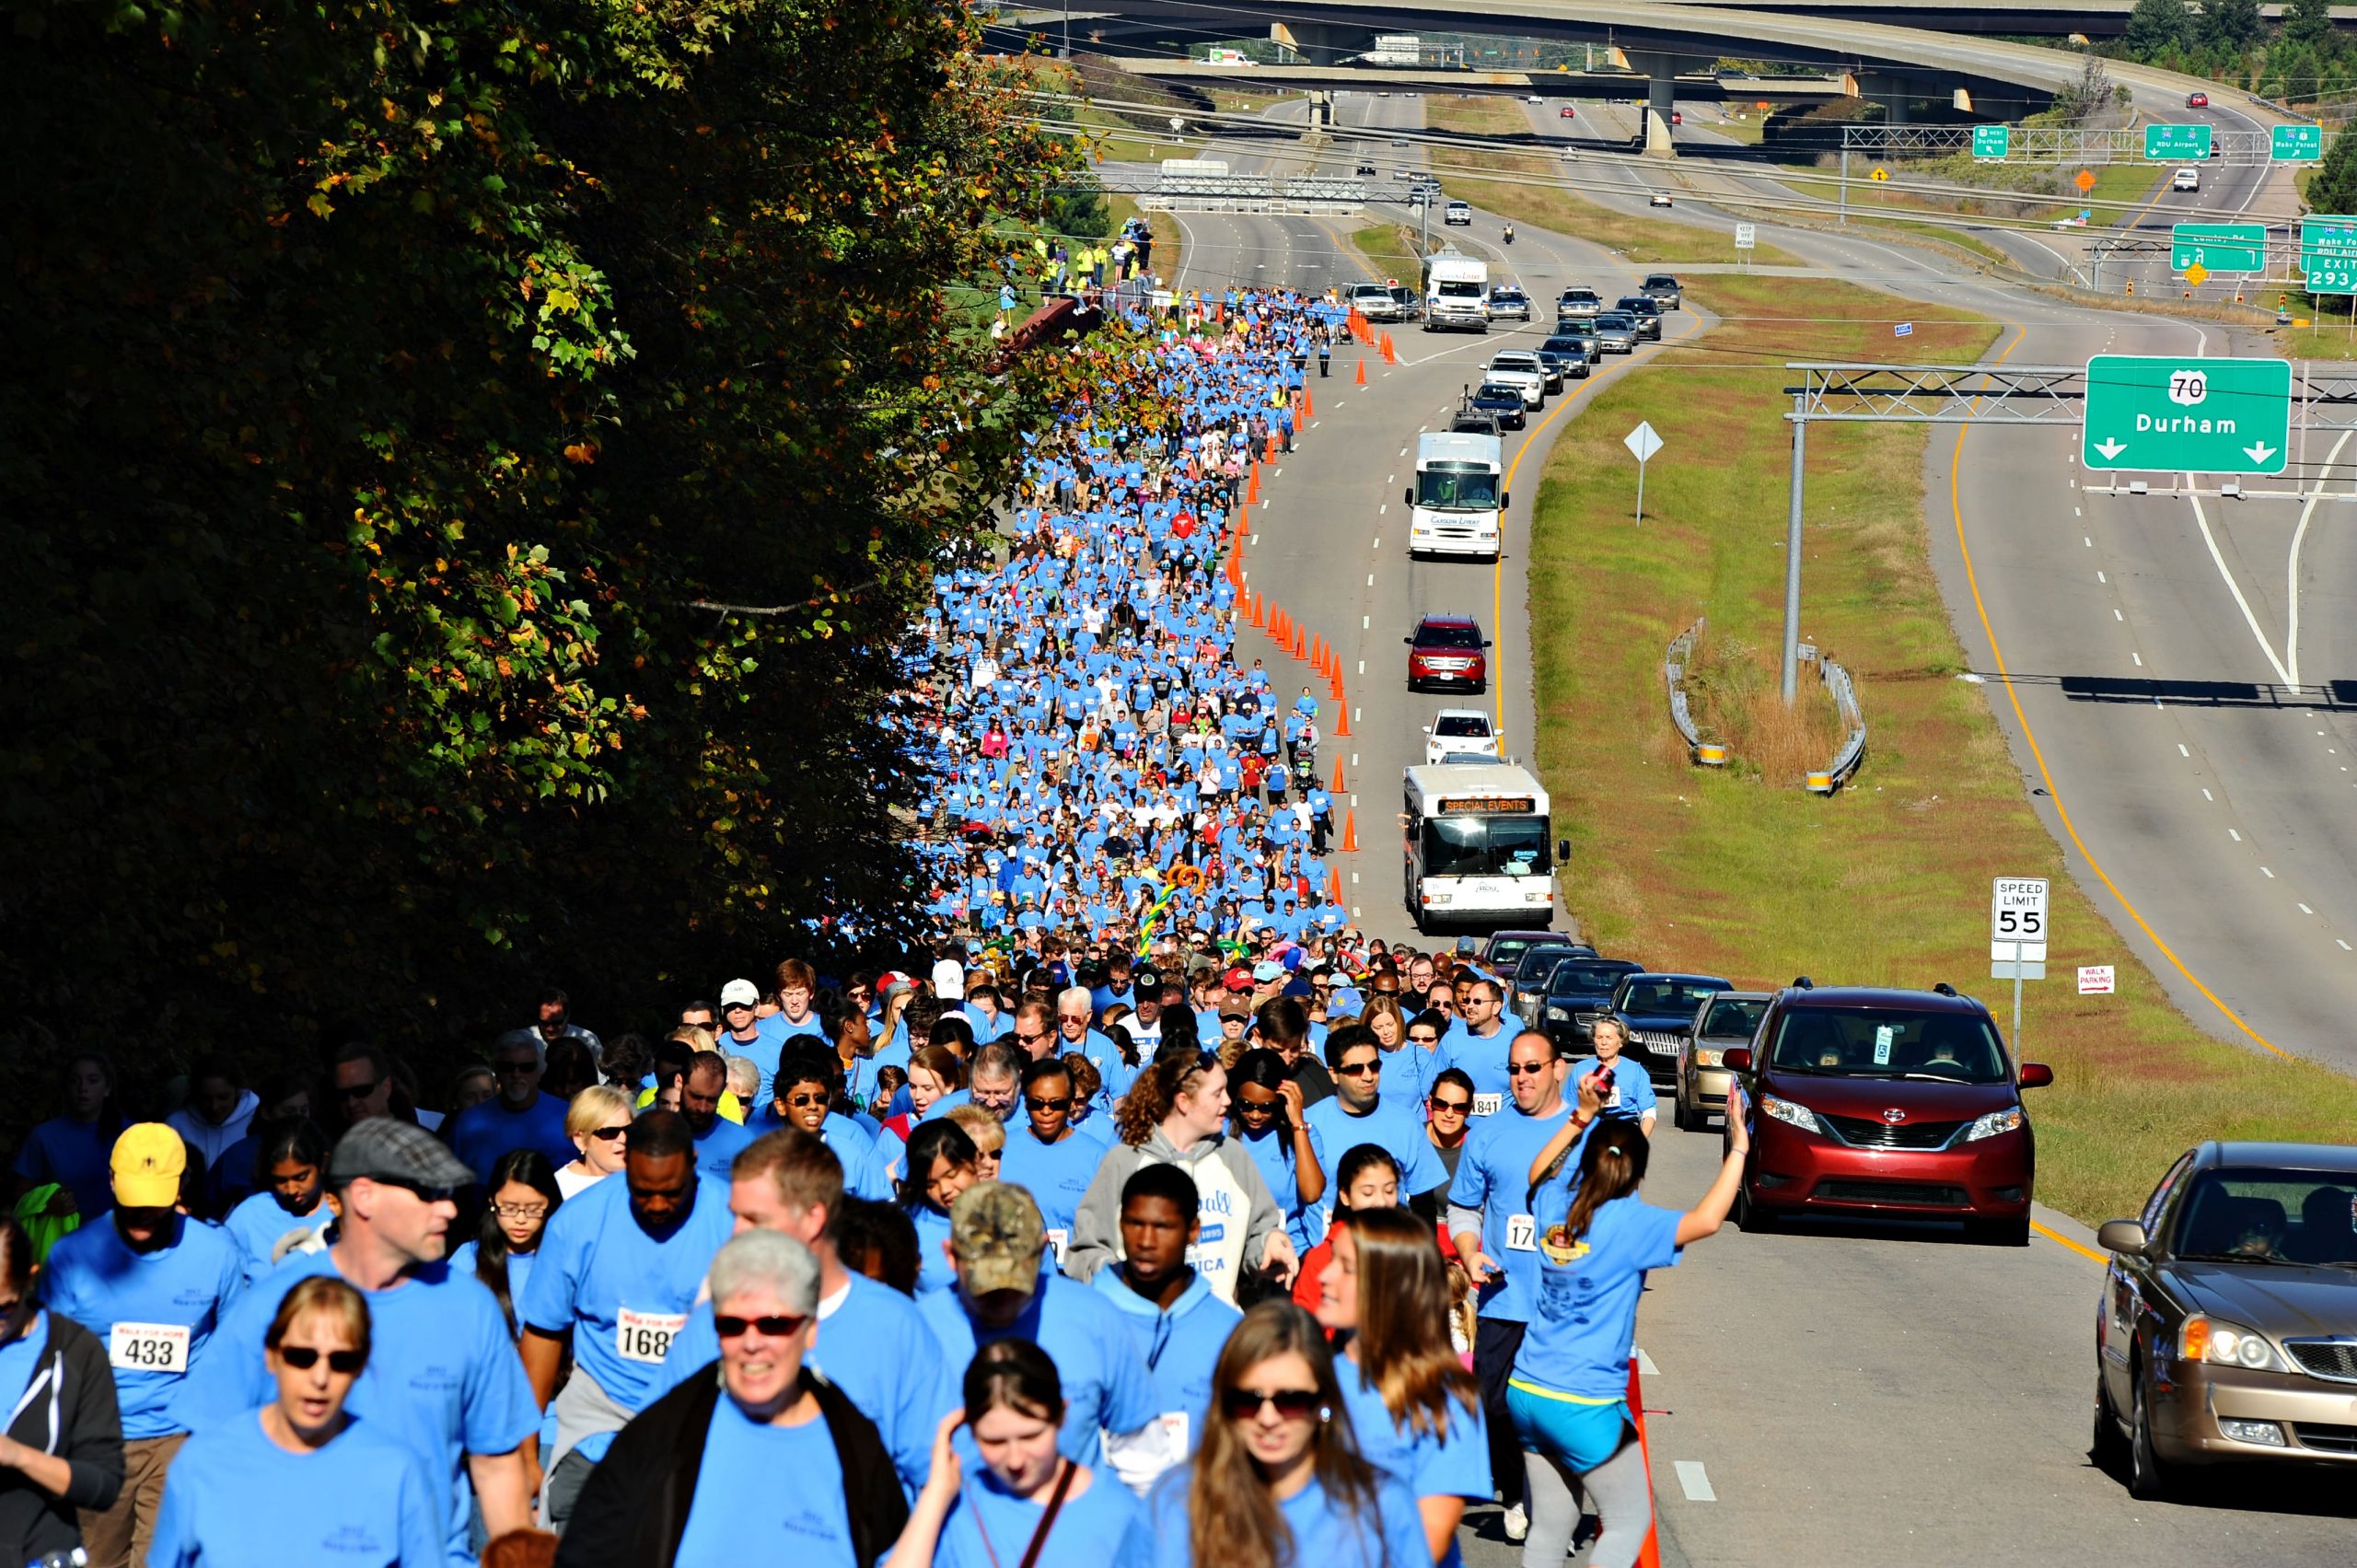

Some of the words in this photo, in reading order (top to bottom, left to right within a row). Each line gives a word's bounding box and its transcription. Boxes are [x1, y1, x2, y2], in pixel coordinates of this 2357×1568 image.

[2318, 238, 2342, 246] Wake
[2324, 259, 2357, 270] EXIT
[2310, 271, 2349, 286] 293
[2173, 378, 2202, 398] 70
[2136, 413, 2236, 434] Durham
[1446, 801, 1486, 811] SPECIAL
[1488, 800, 1527, 810] EVENTS
[2000, 884, 2043, 894] SPEED
[2003, 897, 2038, 906] LIMIT
[2000, 911, 2041, 934] 55
[2081, 976, 2111, 984] PARKING
[125, 1339, 173, 1365] 433
